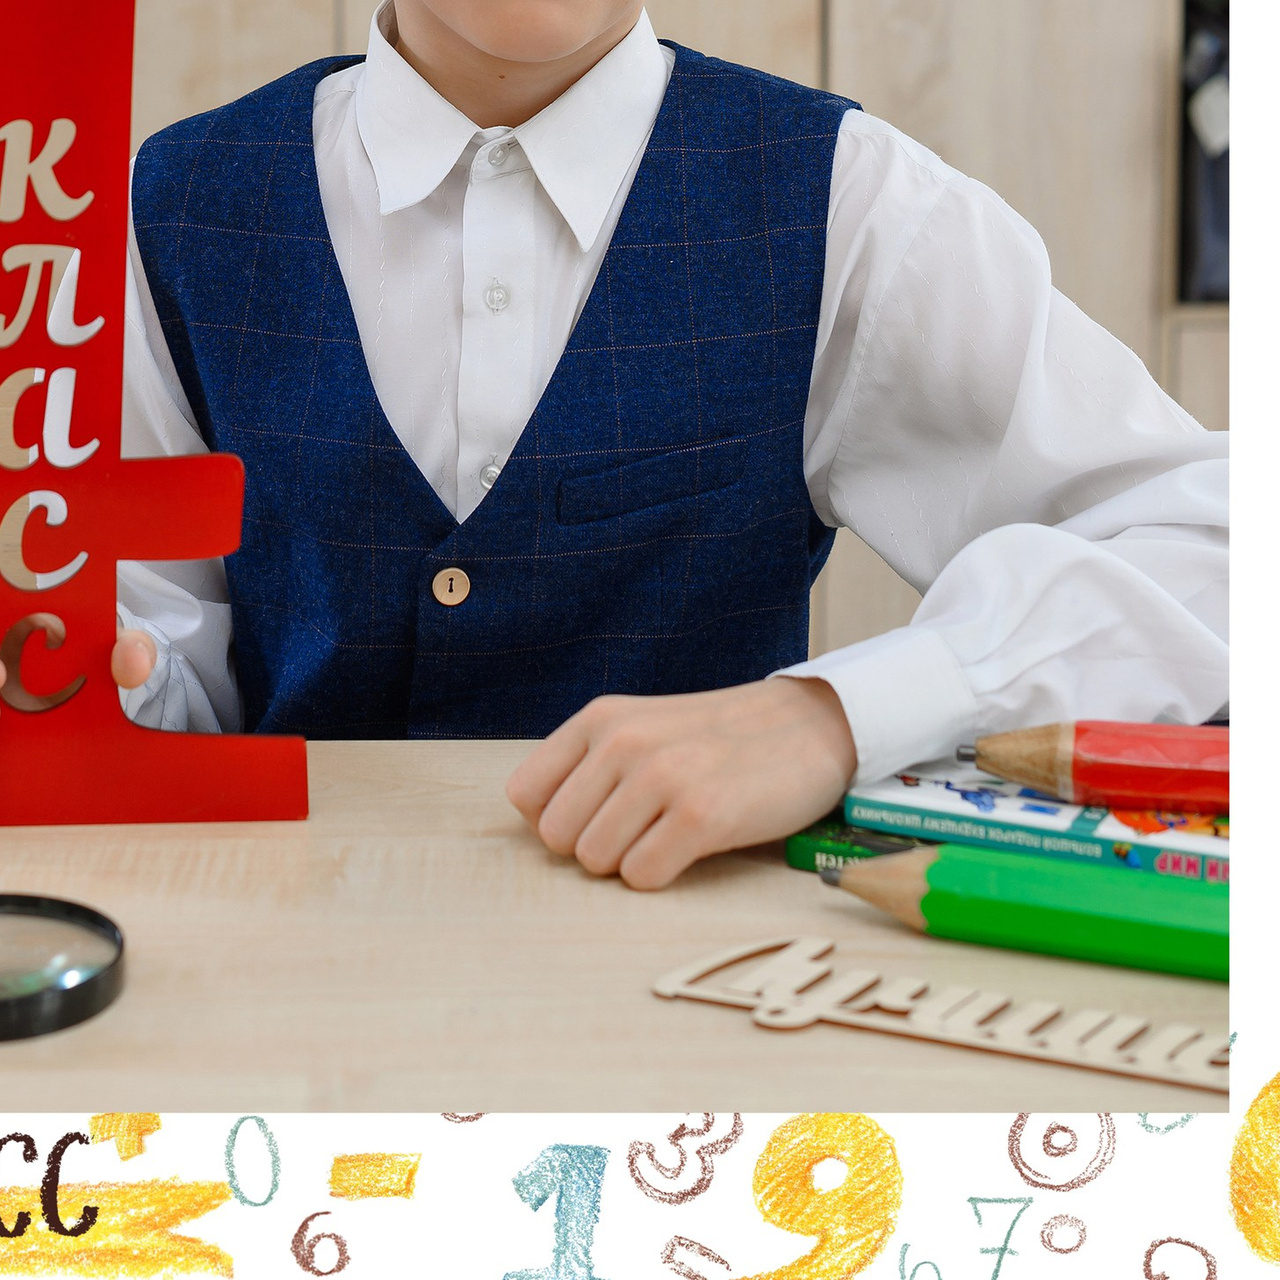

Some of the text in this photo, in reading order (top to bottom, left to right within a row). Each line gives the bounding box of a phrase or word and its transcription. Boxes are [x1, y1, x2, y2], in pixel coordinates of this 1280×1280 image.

[851, 805, 922, 830] ШКОЛЬНИКУ
[987, 827, 1042, 848] ПОДАРОК
[1042, 836, 1102, 858] БОЛЬШОЙ
[1154, 849, 1202, 881] МИР
